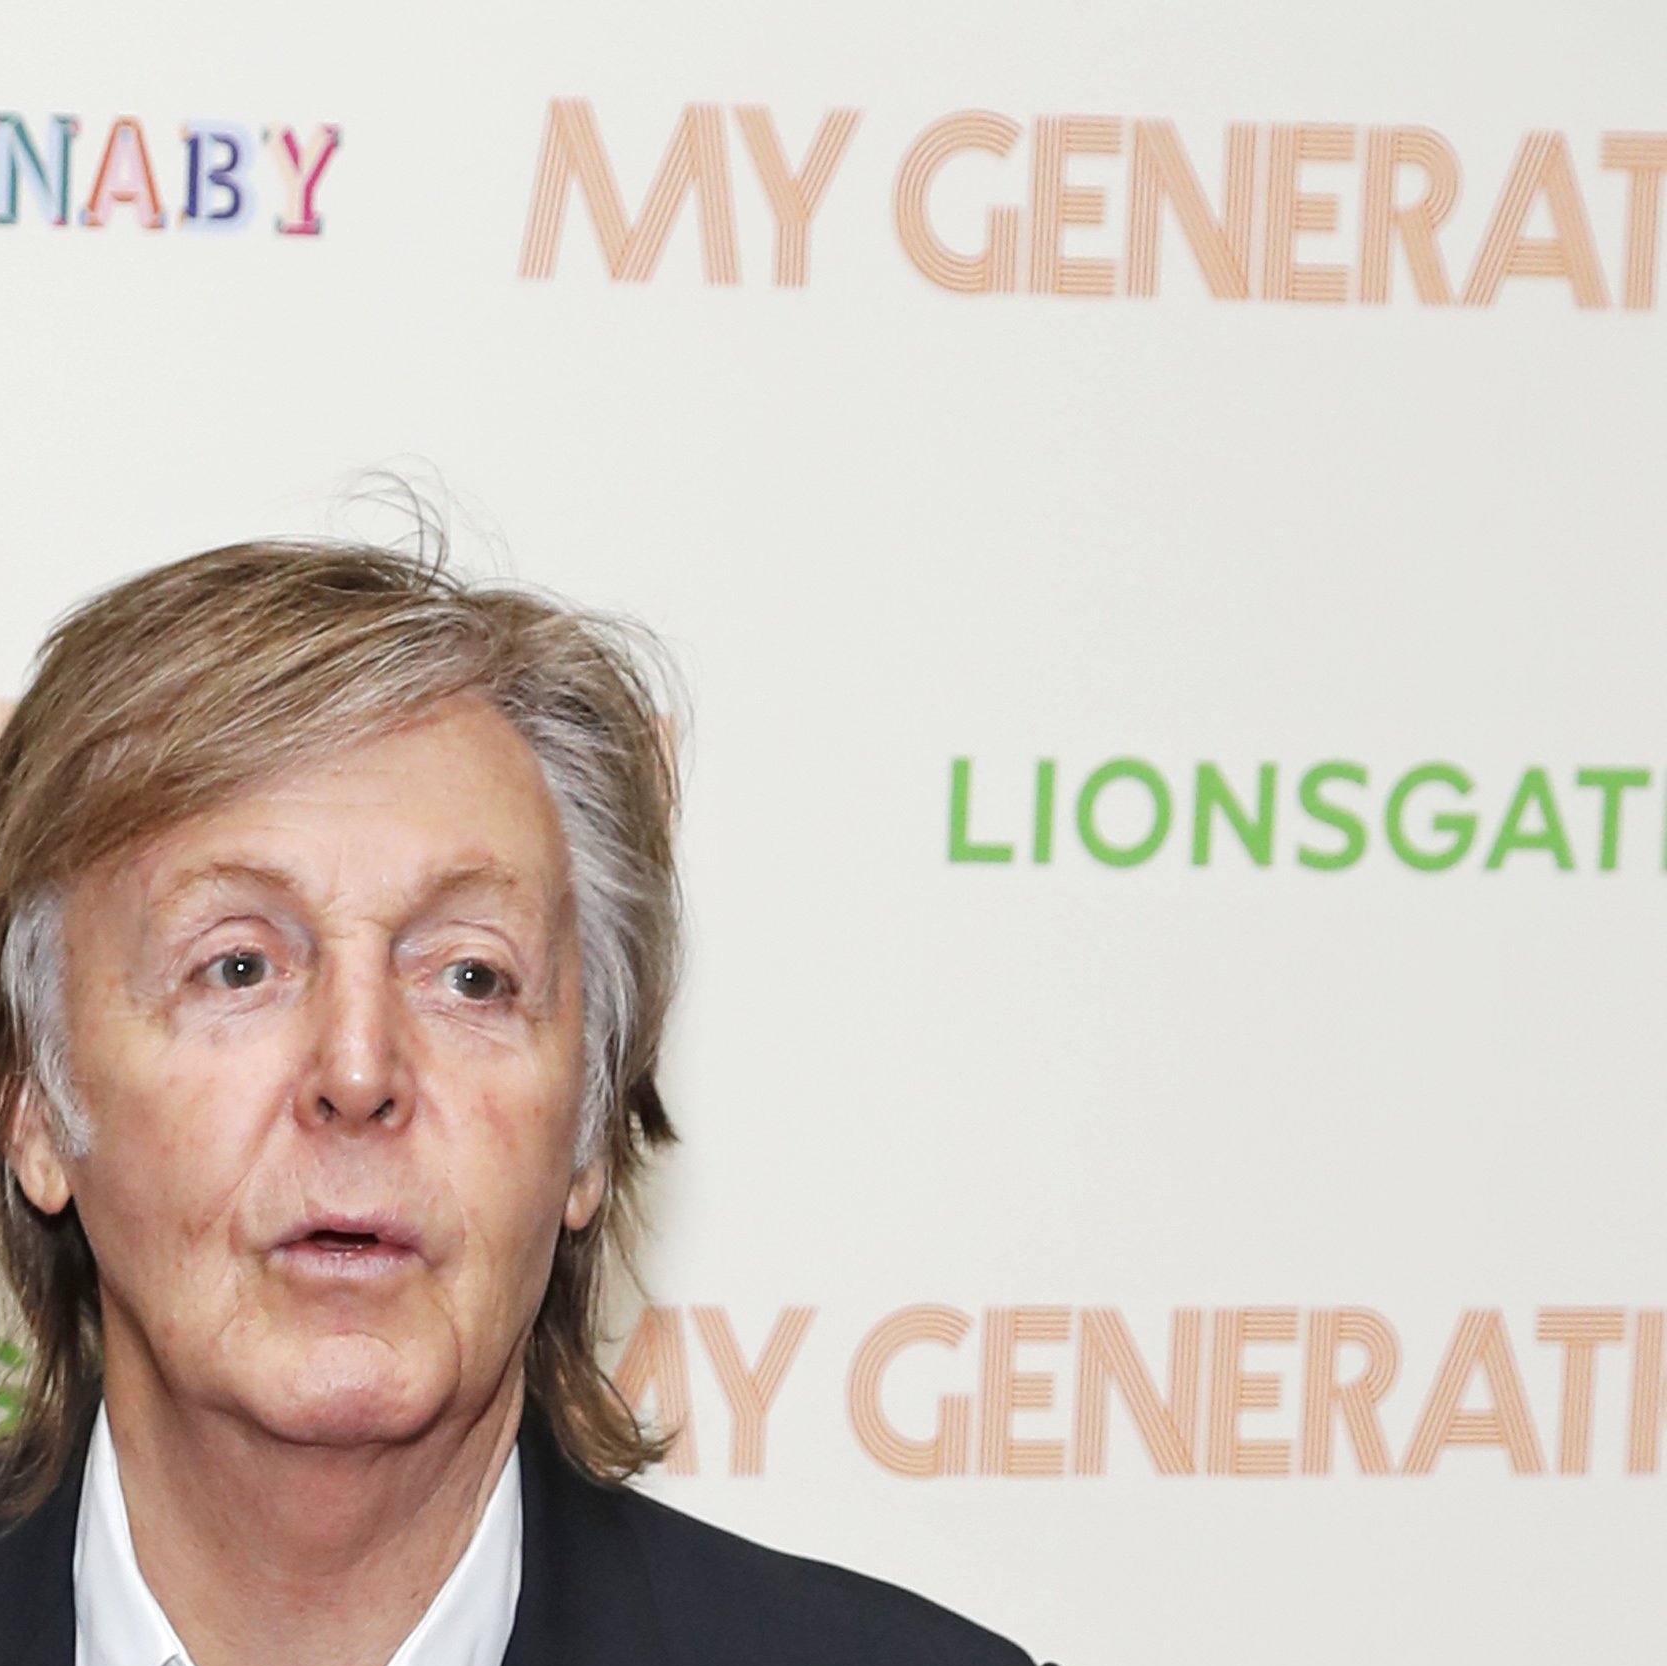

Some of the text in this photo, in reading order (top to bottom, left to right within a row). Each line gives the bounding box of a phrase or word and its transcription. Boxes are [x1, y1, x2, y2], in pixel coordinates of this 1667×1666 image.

[517, 95, 1667, 311] MY GENERAT
[947, 757, 1667, 873] LIONSGAT
